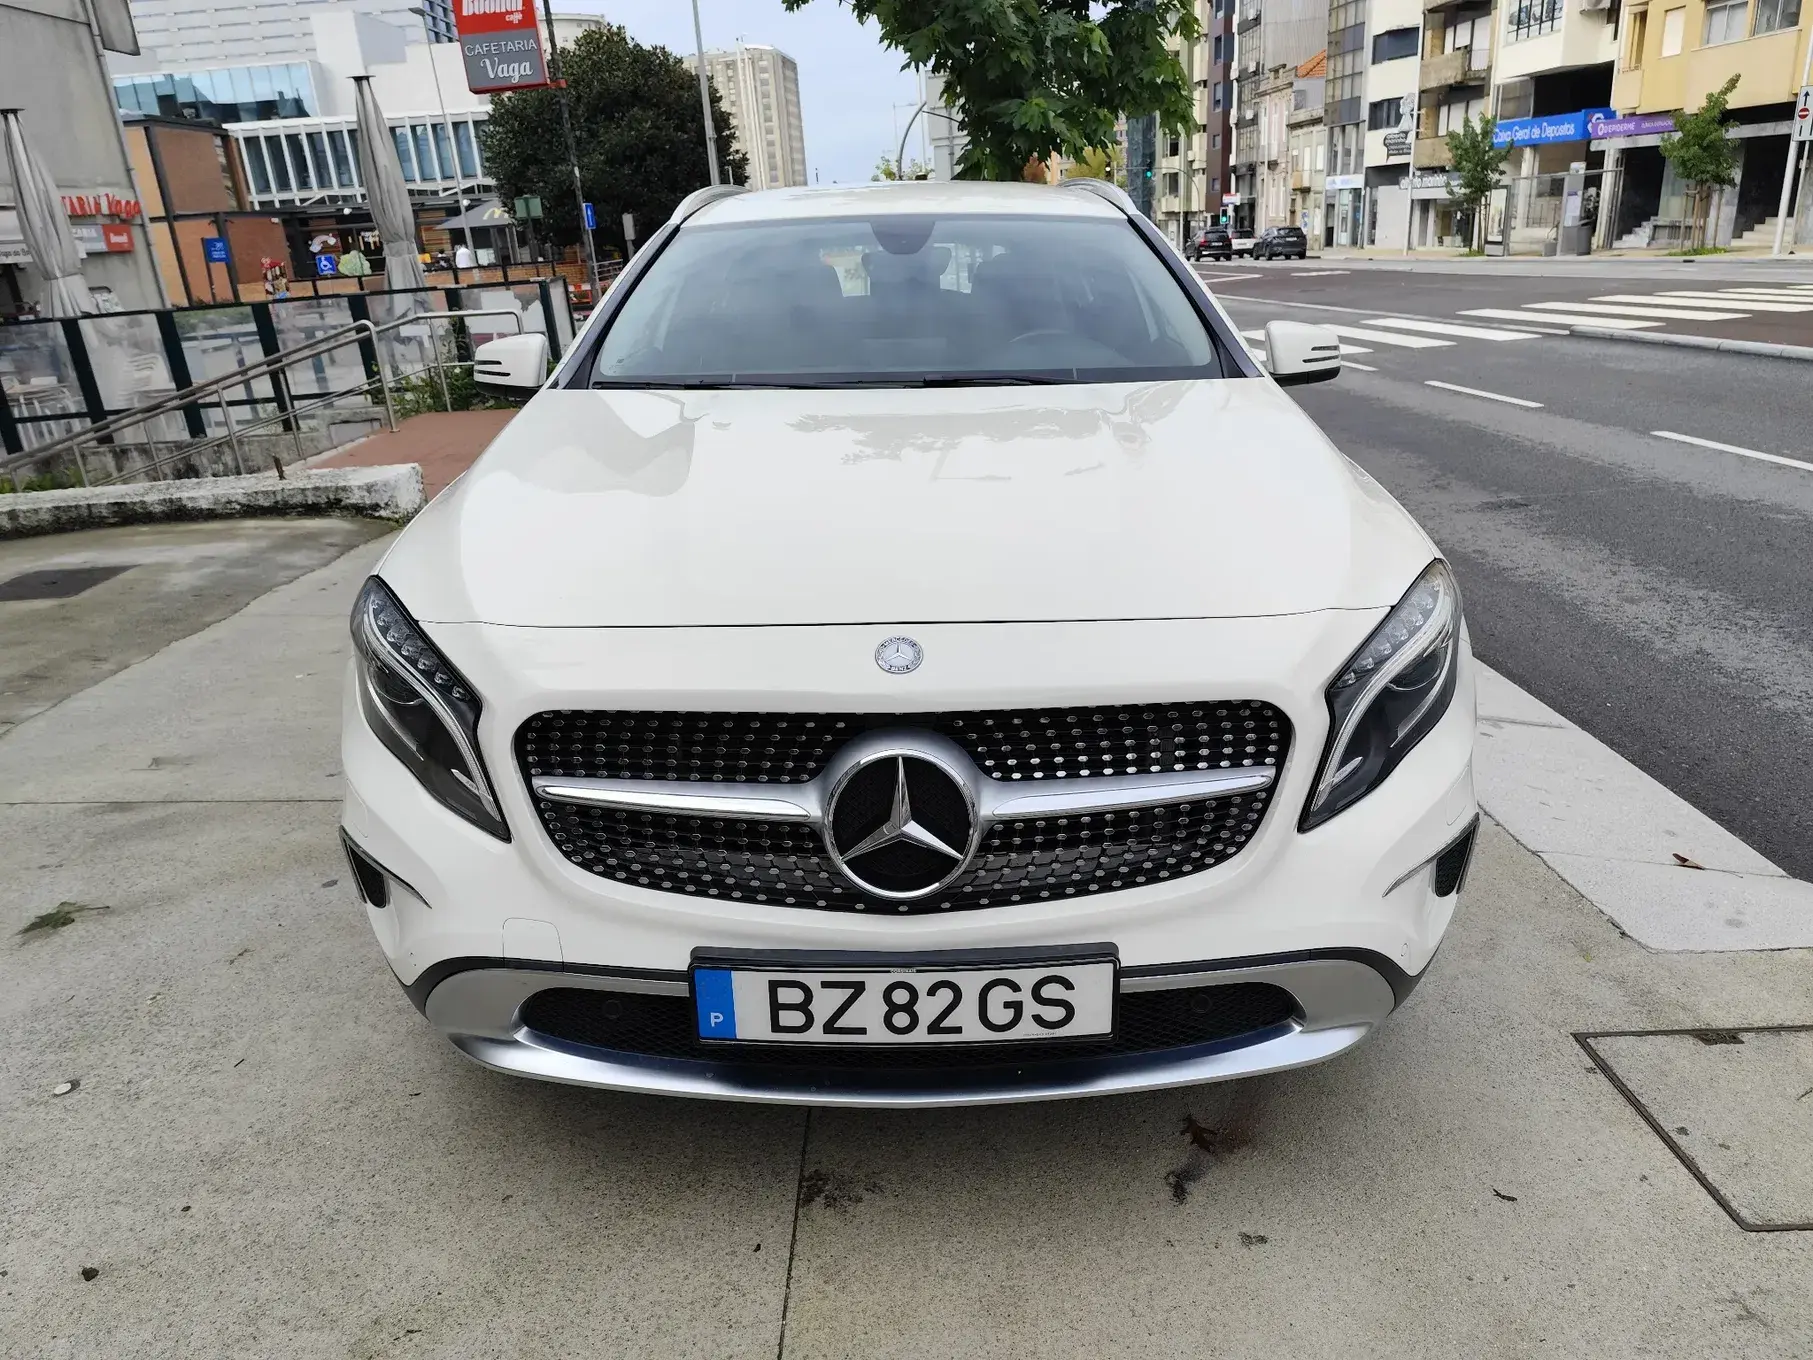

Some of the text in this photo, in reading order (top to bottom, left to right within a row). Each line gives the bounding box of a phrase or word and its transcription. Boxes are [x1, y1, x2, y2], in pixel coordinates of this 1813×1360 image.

[464, 39, 538, 57] CAFETARIA
[480, 57, 533, 83] Vaga
[1512, 126, 1531, 141] Geral
[1531, 124, 1540, 139] de
[103, 192, 141, 218] Vaga
[710, 974, 1077, 1036] P BZ 82 GS
